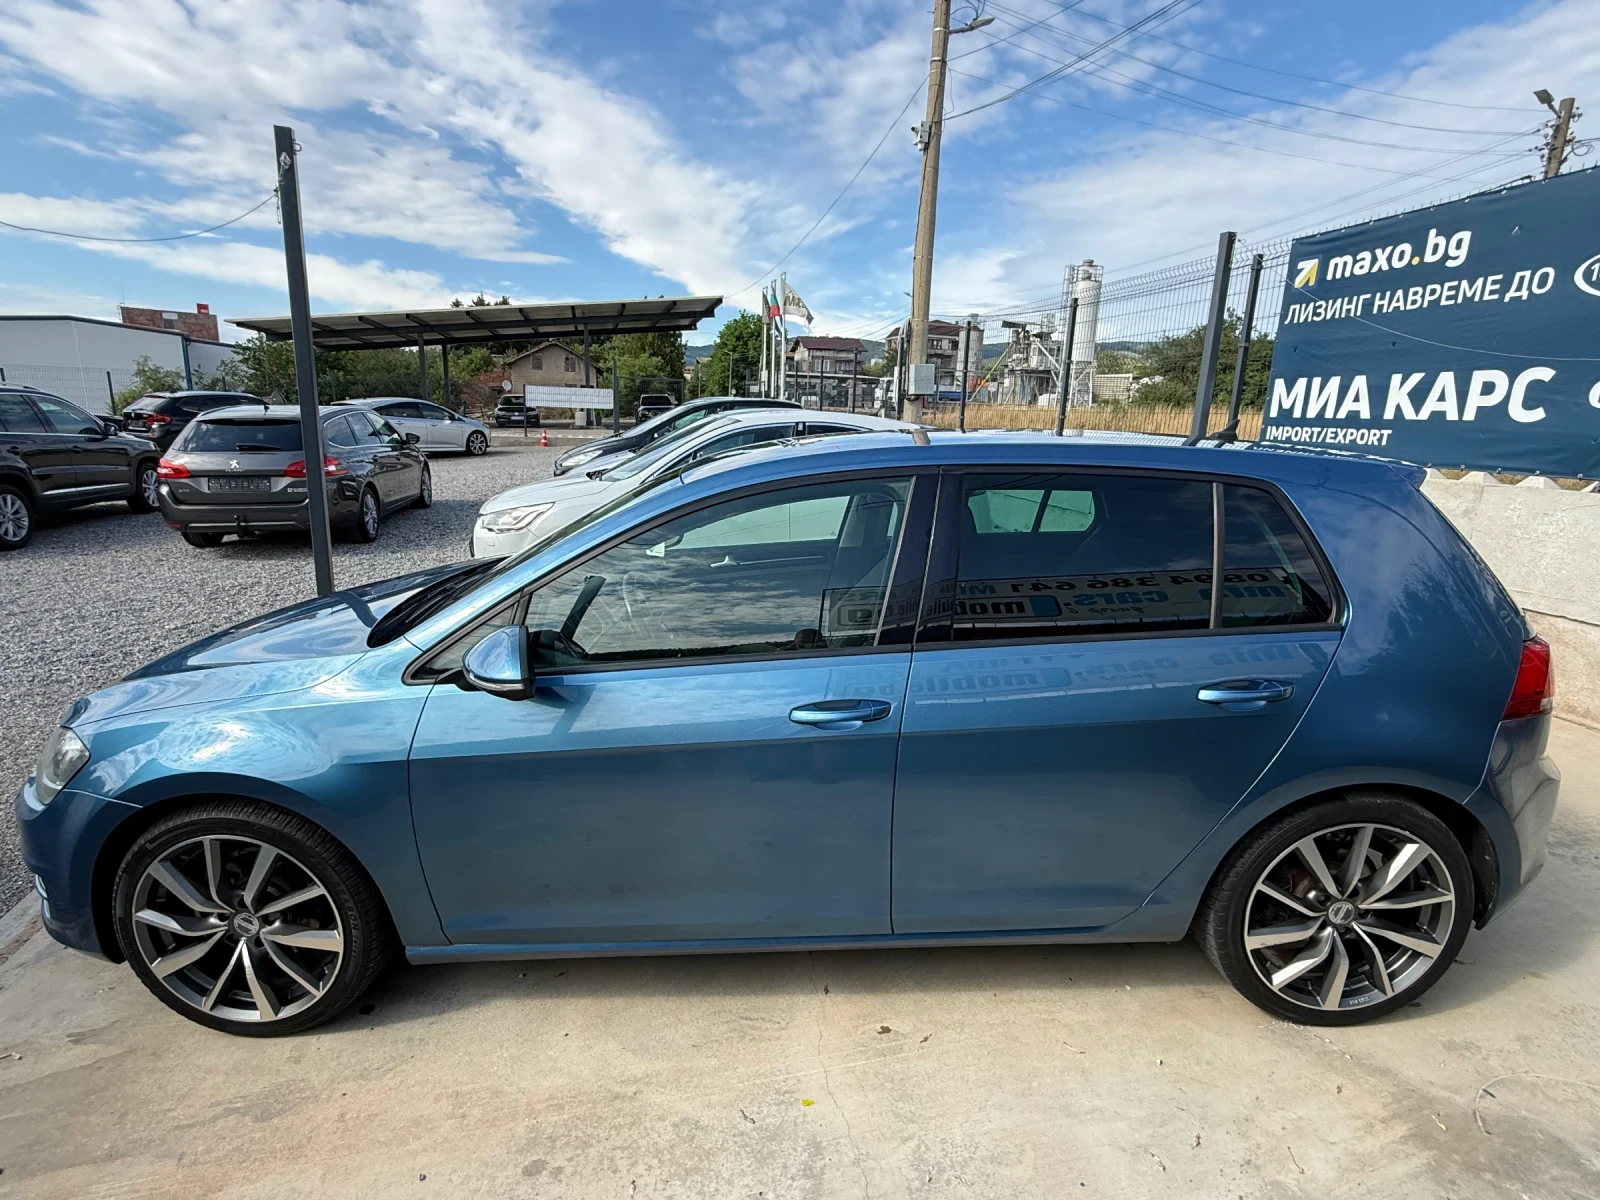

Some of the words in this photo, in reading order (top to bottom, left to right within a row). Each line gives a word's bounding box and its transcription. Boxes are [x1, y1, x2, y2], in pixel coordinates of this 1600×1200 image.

[1326, 228, 1472, 281] maxo.bg
[1284, 294, 1371, 325] ЛИЗИНГ
[1372, 274, 1503, 315] НАВРЕМЕ
[1503, 266, 1556, 303] ДО
[1269, 375, 1371, 420] МИА
[1383, 366, 1557, 423] КАРС
[1265, 426, 1392, 446] IMPORT/EXPORT
